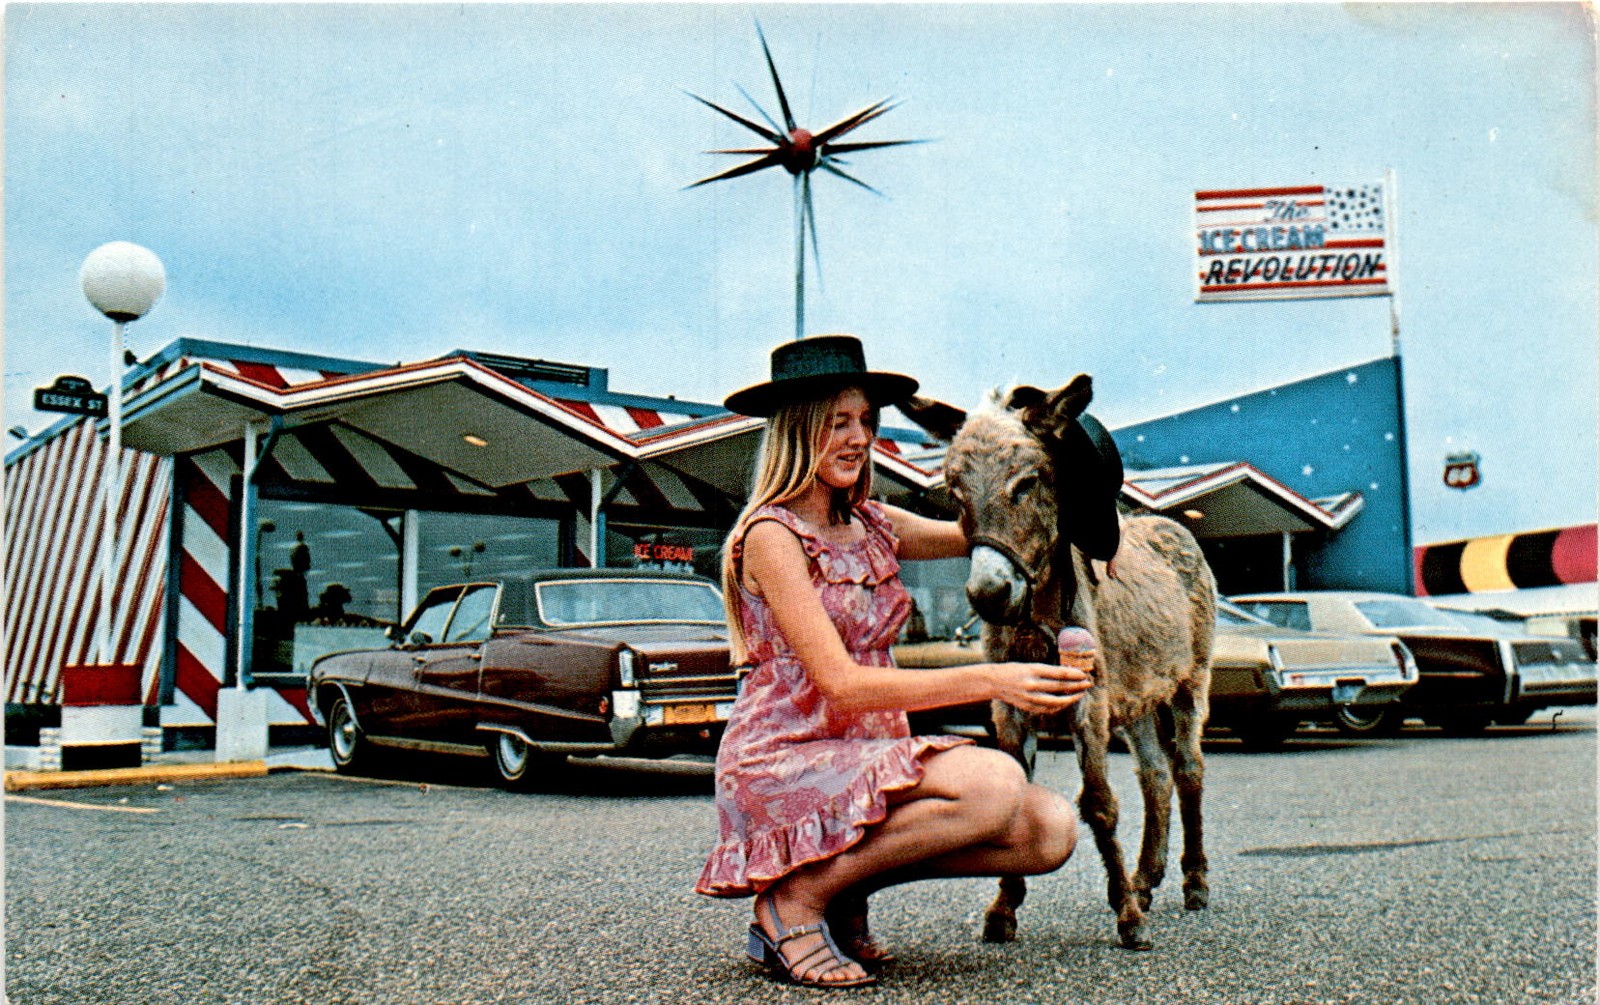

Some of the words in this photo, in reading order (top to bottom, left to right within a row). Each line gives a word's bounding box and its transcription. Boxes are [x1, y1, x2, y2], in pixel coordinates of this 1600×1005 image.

[1264, 200, 1310, 221] The
[1200, 229, 1238, 253] ICE
[1241, 224, 1325, 251] CREAM
[1204, 253, 1382, 285] REVOLUTION
[42, 393, 82, 408] ESSEX
[87, 400, 103, 410] ST
[633, 543, 650, 559] ICE
[653, 545, 694, 561] CREAM
